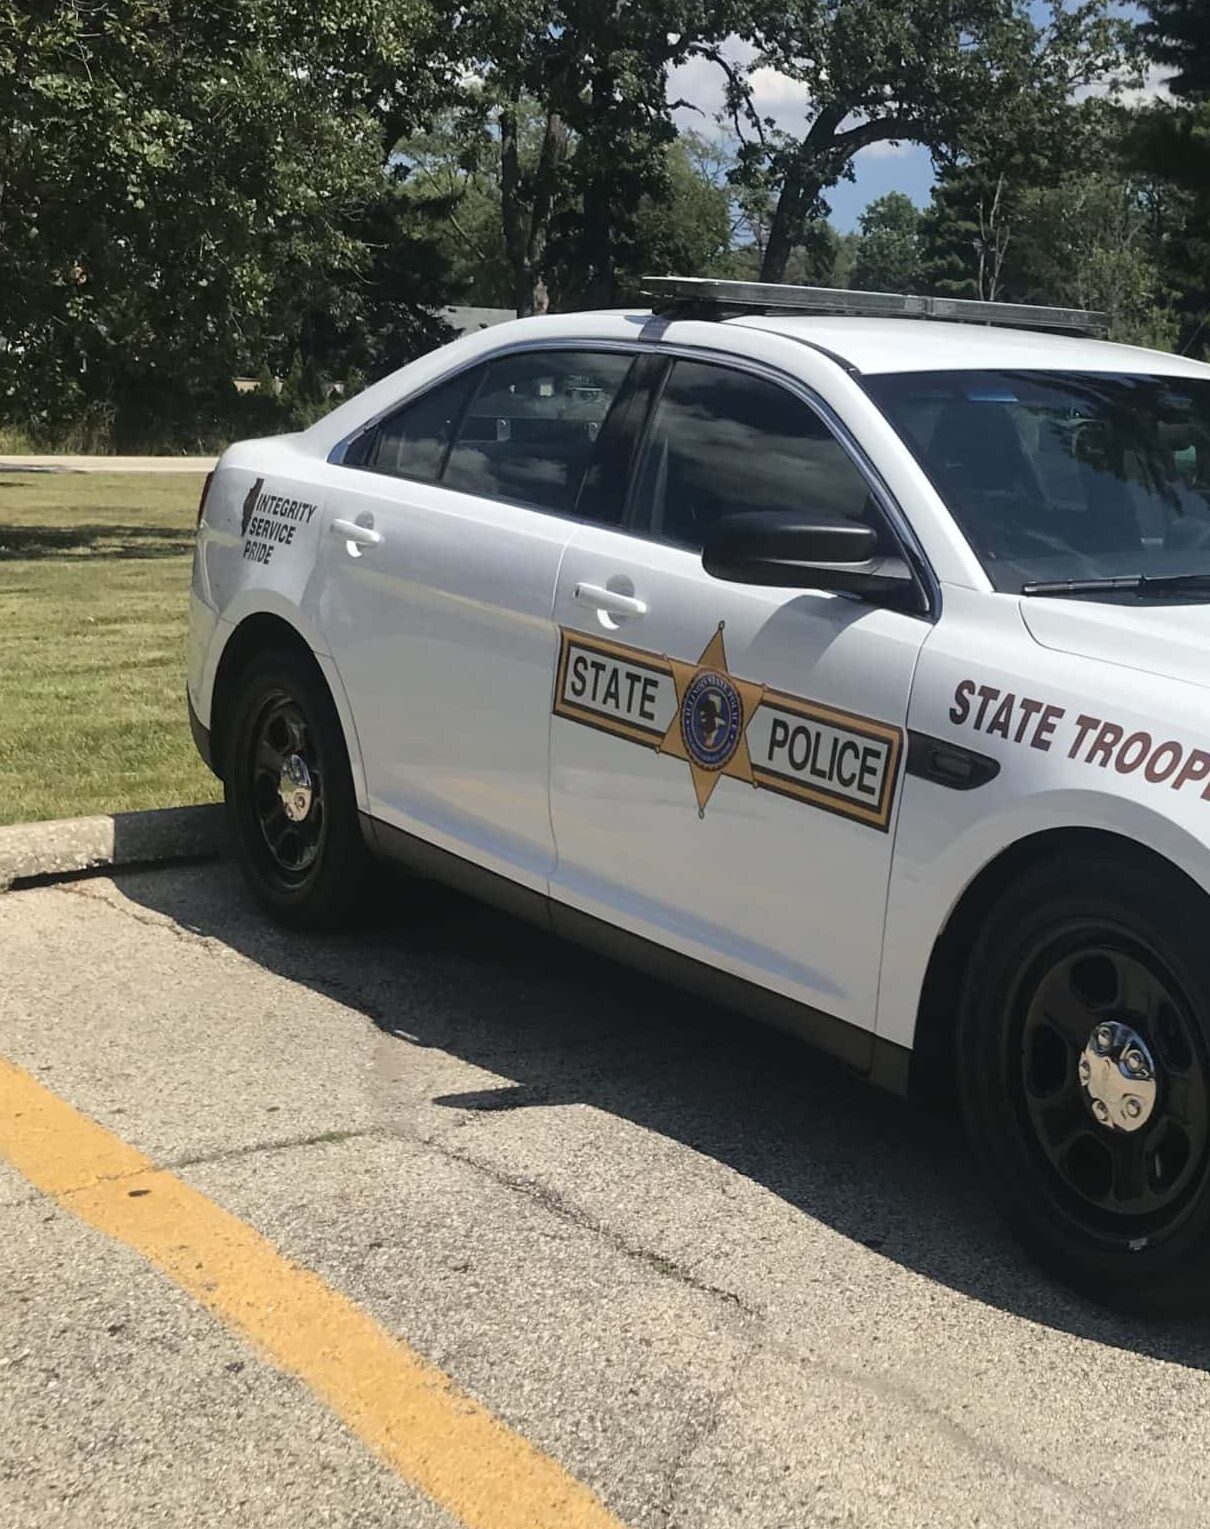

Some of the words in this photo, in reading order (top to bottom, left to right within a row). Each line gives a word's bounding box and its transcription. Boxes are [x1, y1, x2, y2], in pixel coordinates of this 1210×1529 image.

[256, 493, 318, 523] INTEGRITY
[249, 517, 296, 545] SERVICE
[243, 541, 274, 565] PRIDE
[570, 655, 660, 722] STATE
[767, 717, 882, 797] POLICE
[949, 679, 1066, 752] STATE
